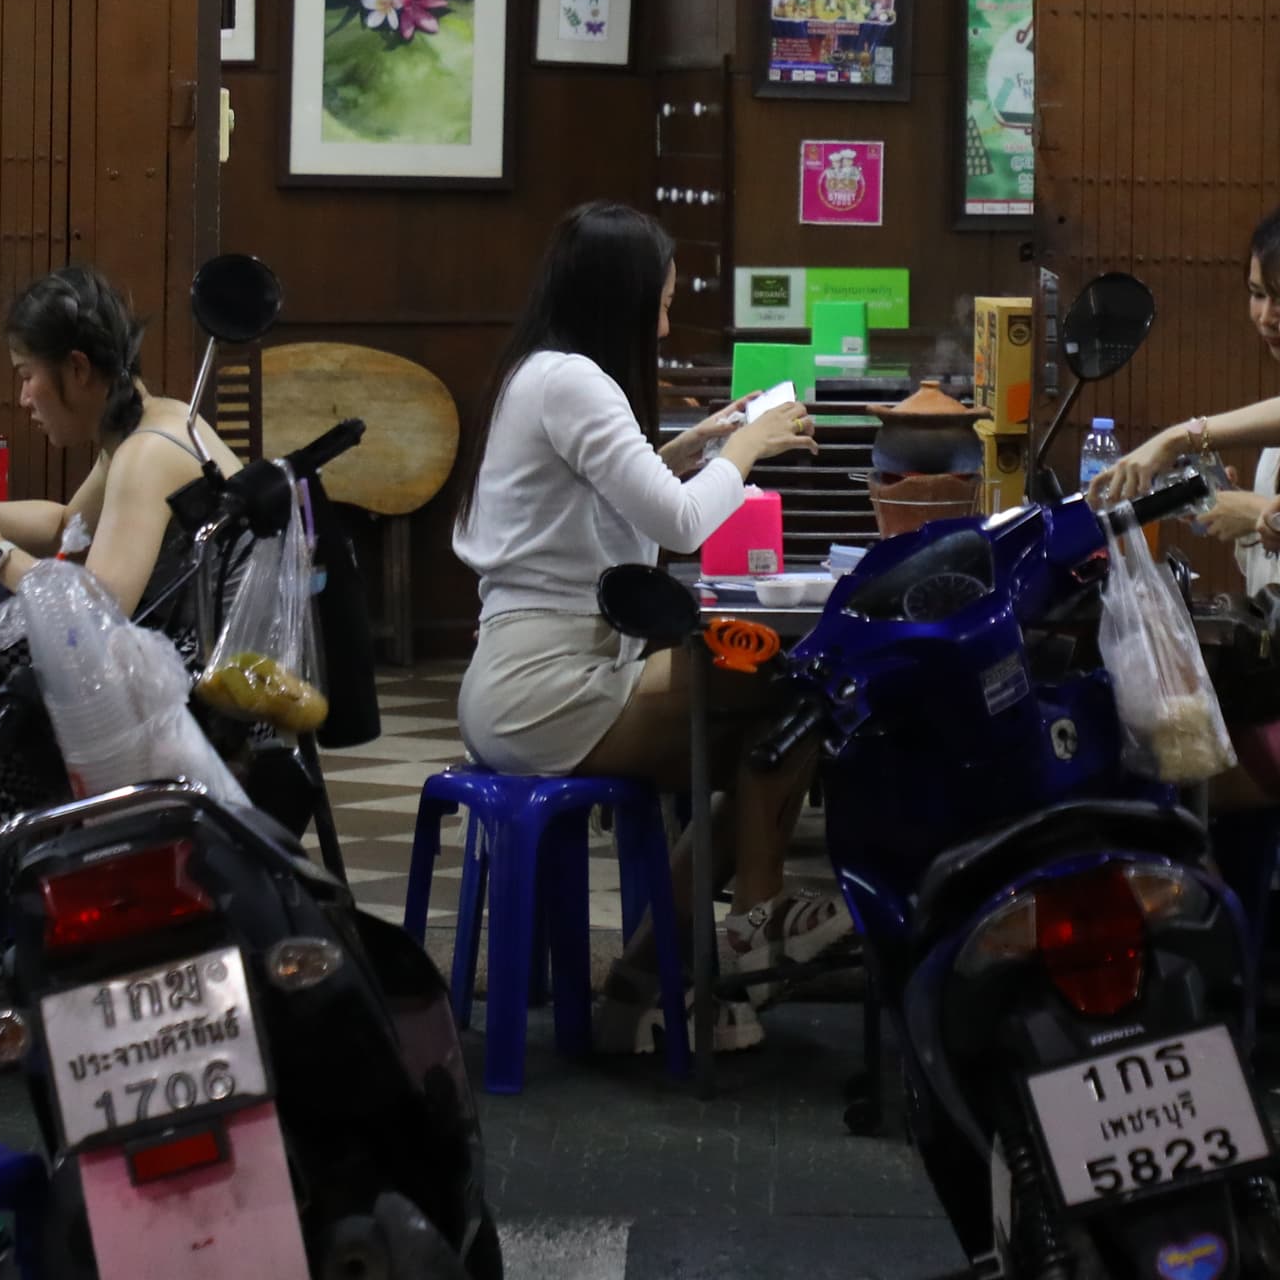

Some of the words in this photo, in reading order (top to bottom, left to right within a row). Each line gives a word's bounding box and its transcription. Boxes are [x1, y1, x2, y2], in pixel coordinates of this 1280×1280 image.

[68, 1005, 241, 1082] ประจวบคีรีขันธ์
[1090, 1023, 1145, 1048] HONDA
[94, 1060, 237, 1130] 1706
[1081, 1042, 1192, 1103] 1กธ
[1099, 1090, 1197, 1142] เพชรบุรี
[1086, 1127, 1238, 1196] 5823
